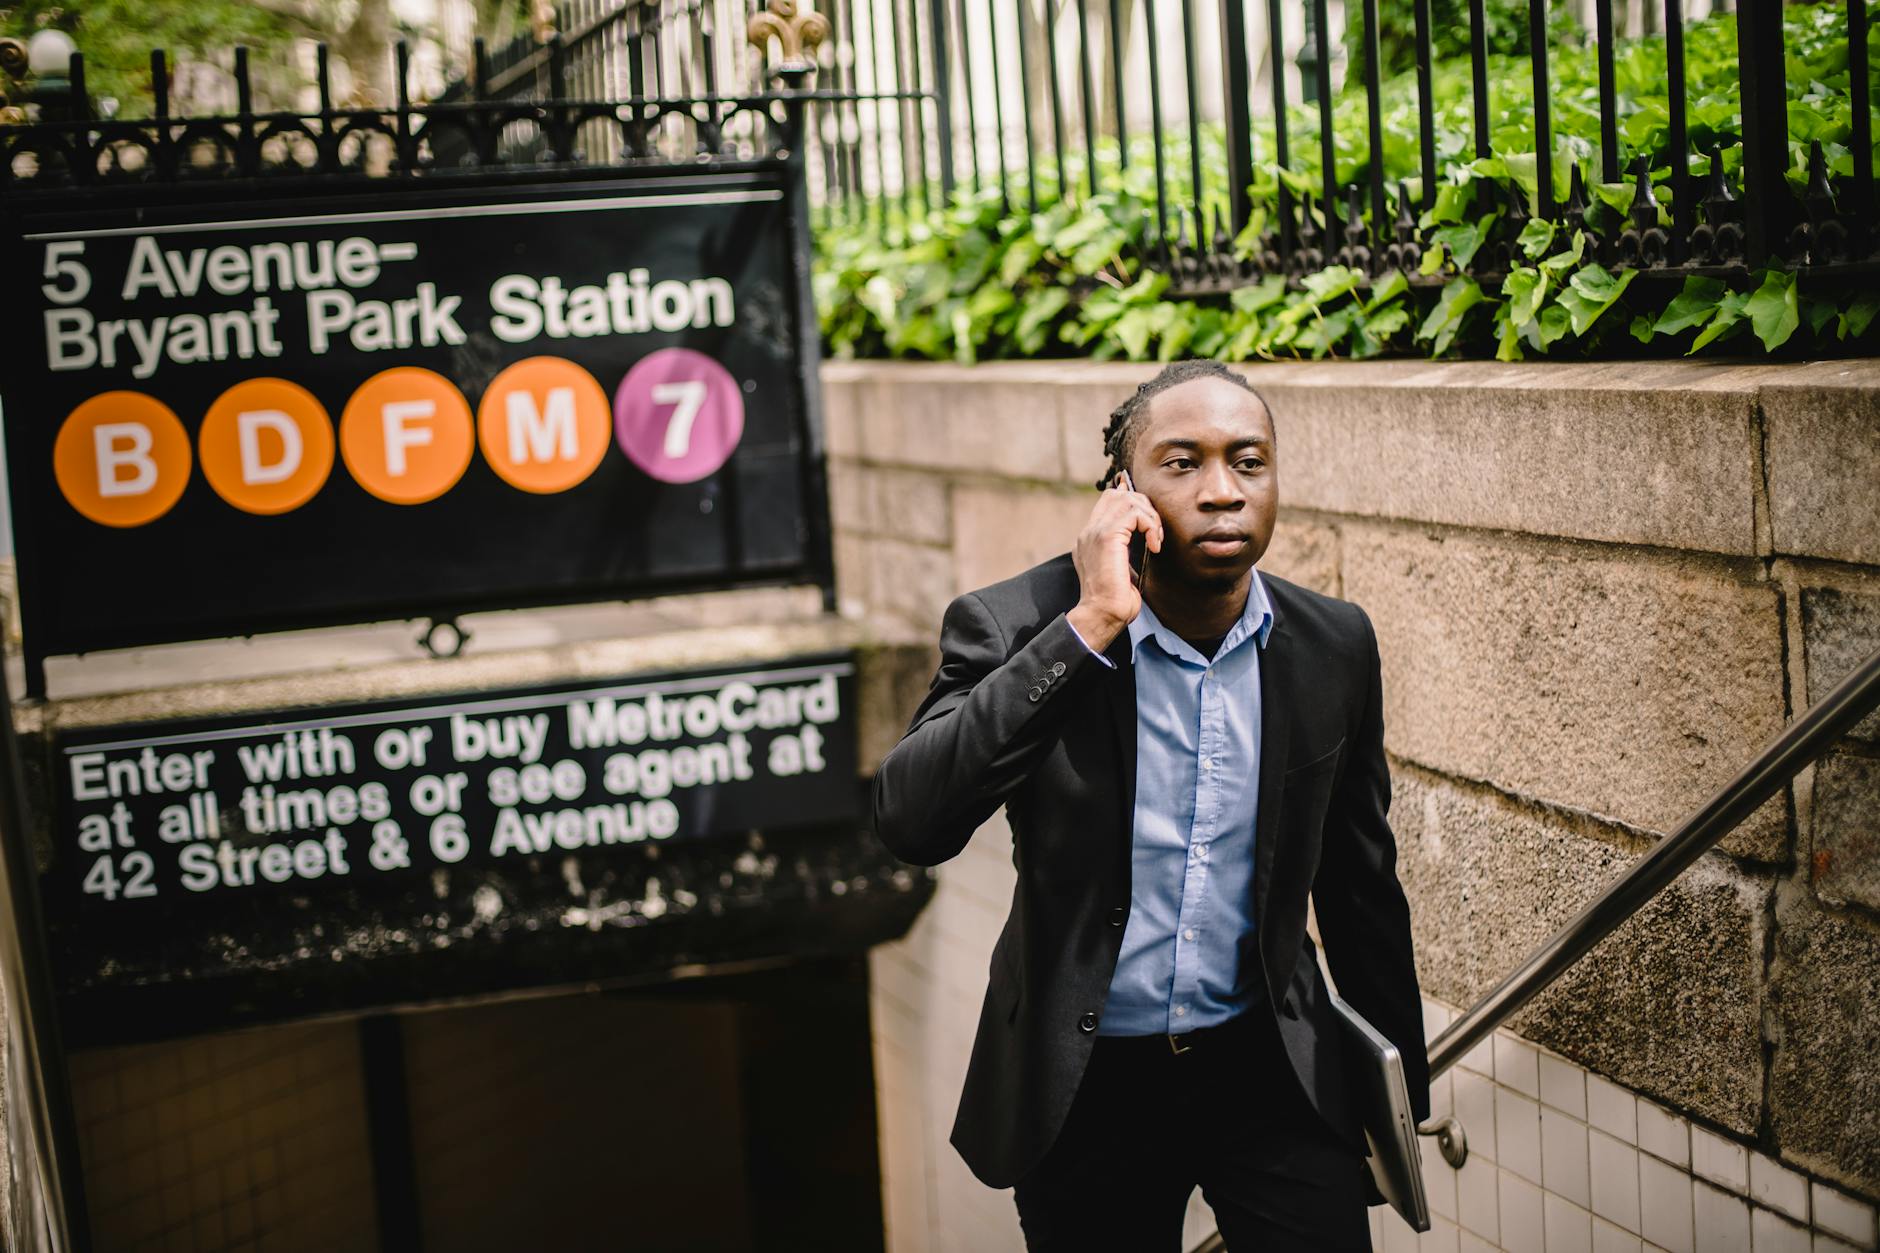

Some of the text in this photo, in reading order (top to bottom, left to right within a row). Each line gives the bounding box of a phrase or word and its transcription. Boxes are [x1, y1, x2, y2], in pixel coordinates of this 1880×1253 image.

[42, 236, 417, 304] 5 Avenue-
[45, 269, 734, 378] Bryant Park Station
[94, 382, 707, 499] B D F M 7
[69, 675, 840, 801] Enter with or buy MetroCard
[78, 726, 825, 853] at all times or see agent at
[83, 799, 680, 902] 42 Street & 6 Avenue
